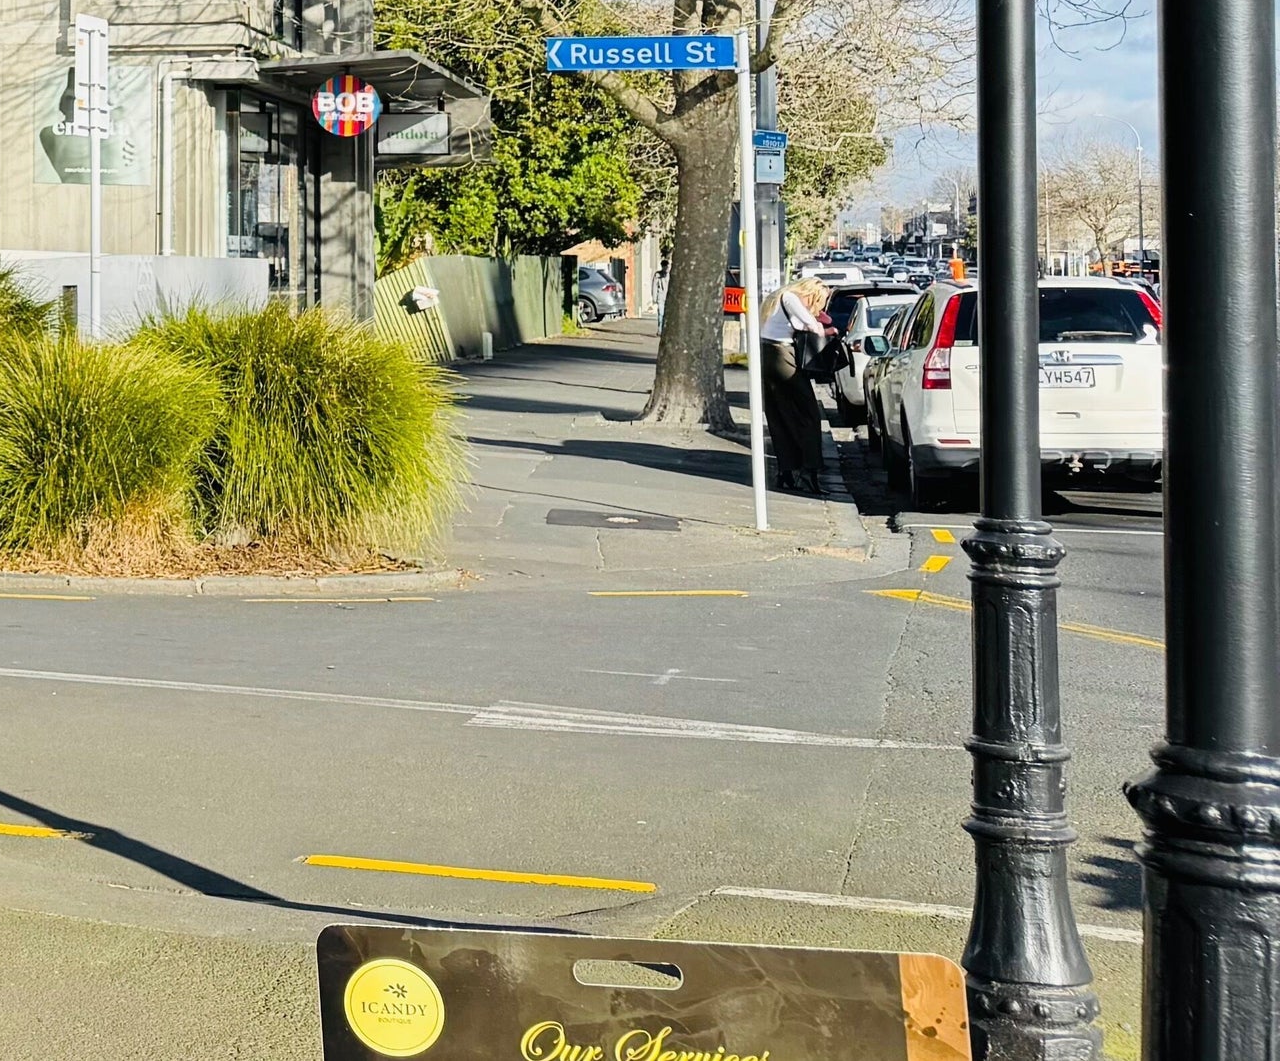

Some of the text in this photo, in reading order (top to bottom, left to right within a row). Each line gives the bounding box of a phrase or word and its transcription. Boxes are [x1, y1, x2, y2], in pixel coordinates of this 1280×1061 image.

[571, 41, 716, 65] Russell St
[318, 92, 374, 112] BOB
[362, 1002, 427, 1016] ICANDY
[521, 1021, 603, 1061] Our
